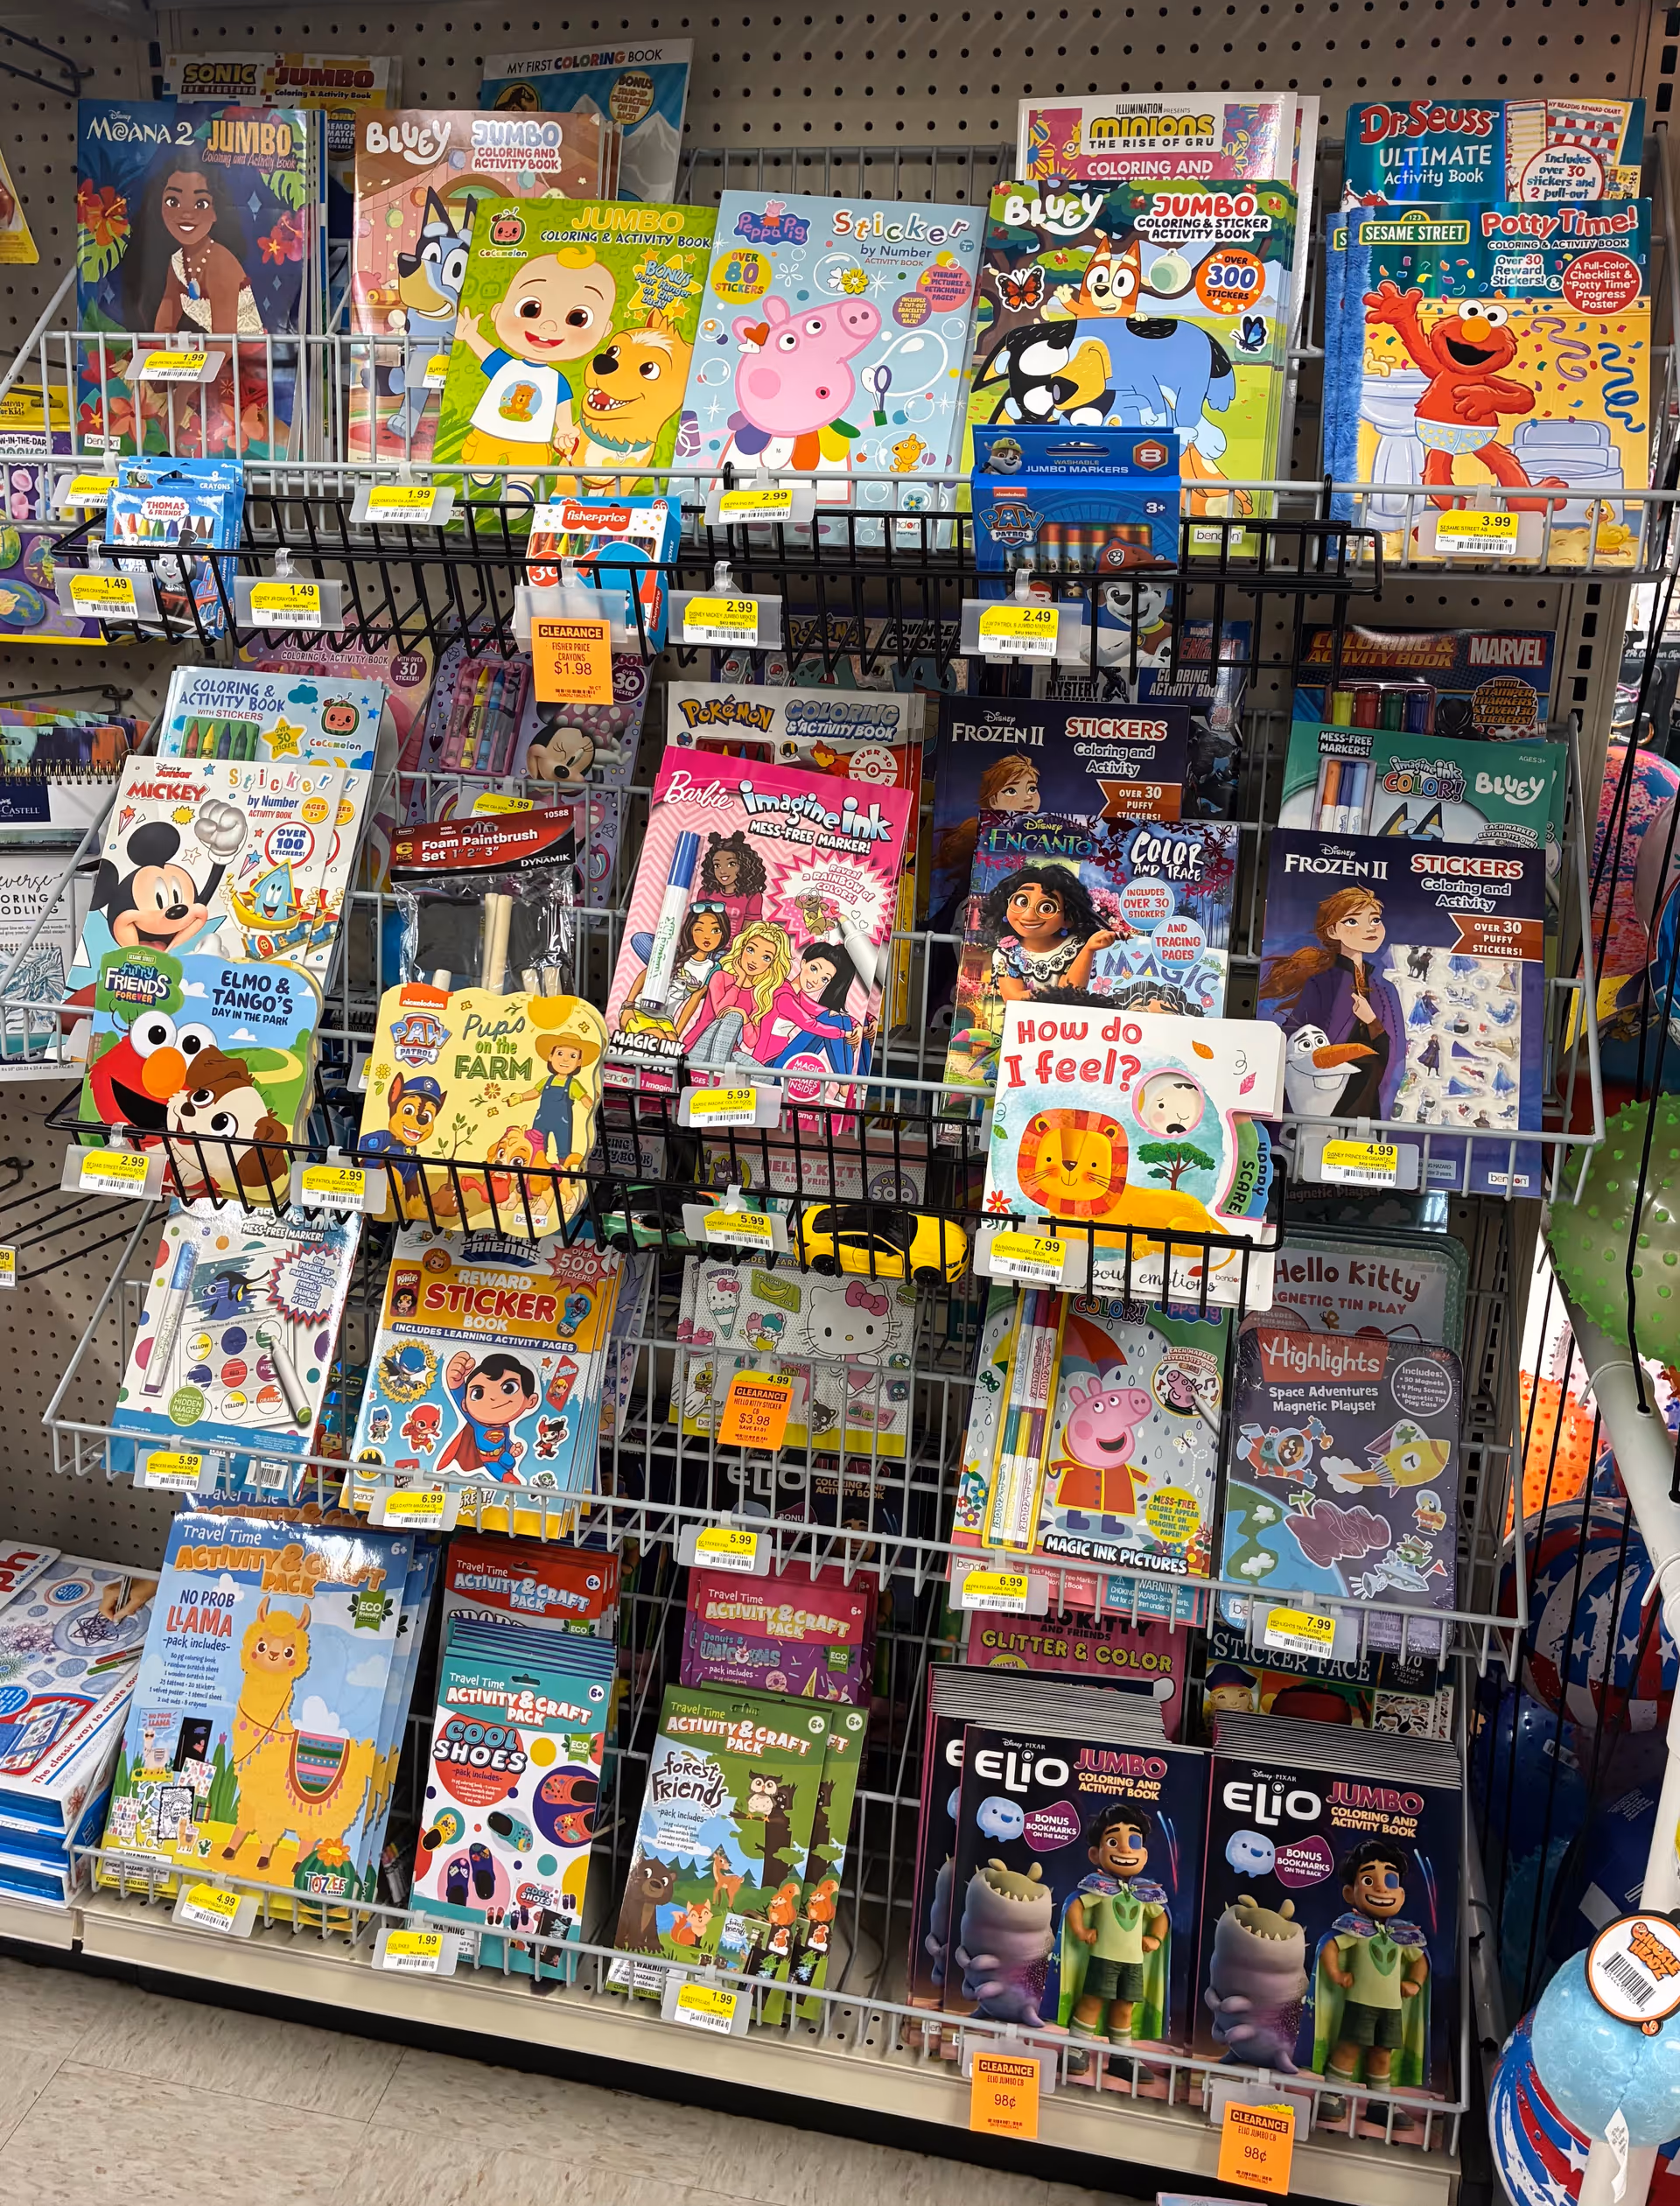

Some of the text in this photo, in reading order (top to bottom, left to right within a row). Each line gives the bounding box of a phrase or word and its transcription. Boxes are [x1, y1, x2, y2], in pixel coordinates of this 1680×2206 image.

[508, 49, 662, 74] MY FIRST COLORING BOOK
[183, 64, 257, 83] SONIC
[87, 116, 195, 146] MOANA 2
[206, 120, 291, 156] JUMBO
[472, 120, 563, 148] JUMBO
[366, 120, 452, 165] BLUEY
[1089, 137, 1214, 148] THE RISE OF GRU
[1380, 144, 1492, 166] ULTIMATE
[1384, 168, 1483, 186] Activity Book
[572, 207, 684, 233] JUMBO
[832, 209, 970, 243] Sticker
[1482, 206, 1638, 237] Potty Time!
[541, 231, 710, 249] COLORING & ACTIVITY BOOK
[1365, 225, 1464, 240] SESAME STREET
[732, 252, 759, 263] OVER
[860, 244, 932, 258] by Number
[1224, 256, 1248, 264] OVER
[724, 263, 760, 283] 80
[1208, 265, 1256, 288] 300
[715, 283, 764, 295] STICKERS
[1207, 290, 1249, 299] STICKERS
[1140, 448, 1161, 462] 8
[147, 501, 185, 511] THOMAS
[1146, 502, 1166, 513] 3+
[567, 510, 626, 523] fisher-price
[1482, 515, 1511, 528] 3.99
[103, 578, 127, 589] 1.49
[289, 585, 314, 596] 1.49
[727, 601, 752, 613] 2.99
[1024, 610, 1051, 623] 2.49
[541, 626, 603, 639] CLEARANCE
[552, 641, 571, 650] FISHER
[1470, 637, 1542, 665] MARVEL
[558, 652, 585, 662] CRAYONS
[554, 663, 592, 676] $1.98
[126, 782, 207, 802] MICKEY
[663, 771, 733, 809] Barbie
[544, 809, 569, 818] 10588
[277, 829, 306, 837] OVER
[422, 830, 537, 850] Foam Paintbrush
[750, 820, 872, 853] MESS-FREE MARKER!
[276, 837, 303, 850] 100
[521, 853, 570, 866] DYNAMIK
[1410, 854, 1522, 879] STICKERS
[1127, 888, 1166, 897] INCLUDES
[1422, 879, 1511, 896] Coloring and
[1124, 899, 1169, 908] OVER 30
[1436, 896, 1495, 912] Activity
[1128, 909, 1166, 918] STICKERS
[220, 970, 290, 995] ELMO &
[212, 988, 293, 1013] TANGO'S
[212, 1008, 288, 1026] DAY IN THE PARK
[463, 1014, 525, 1040] Pups
[1018, 1017, 1143, 1043] How do
[475, 1040, 517, 1054] on the
[454, 1055, 533, 1080] FARM
[1004, 1049, 1141, 1092] I feel?
[727, 1090, 750, 1100] 5.99
[1367, 1145, 1393, 1156] 4.99
[121, 1155, 144, 1167] 2.99
[340, 1170, 362, 1181] 2.99
[741, 1215, 764, 1225] 5.99
[571, 1248, 592, 1258] OVER
[1034, 1238, 1060, 1252] 7.99
[561, 1253, 597, 1275] 500
[458, 1271, 532, 1288] REWARD
[425, 1283, 556, 1323] STICKER
[1339, 1299, 1406, 1315] TIN PLAY
[463, 1315, 508, 1331] BOOK
[395, 1323, 574, 1352] INCLUDES LEARNING ACTIVITY PAGES
[735, 1388, 787, 1401] CLEARANCE
[1269, 1385, 1379, 1403] Space Adventures
[172, 1405, 200, 1415] IMAGES
[739, 1413, 770, 1425] $3.98
[178, 1456, 199, 1465] 5.99
[422, 1494, 443, 1502] 6.99
[731, 1534, 751, 1544] 5.99
[1046, 1537, 1186, 1573] MAGIC INK PICTURES
[1000, 1577, 1022, 1587] 6.99
[180, 1589, 234, 1607] NO PROB
[166, 1606, 232, 1638] LLAMA
[1306, 1616, 1331, 1630] 7.99
[982, 1635, 1173, 1672] GLITTER & COLOR
[450, 1672, 505, 1689] Travel Time
[446, 1687, 592, 1724] ACTIVITY & CRAFT
[507, 1708, 546, 1726] PACK
[445, 1720, 517, 1751] COOL
[433, 1740, 528, 1773] SHOES
[1074, 1748, 1167, 1779] JUMBO
[1078, 1772, 1161, 1790] COLORING AND
[1078, 1783, 1159, 1800] ACTIVITY BOOK
[1035, 1814, 1069, 1825] BONUS
[1026, 1822, 1077, 1835] BOOKMARKS
[216, 1893, 235, 1906] 4.99
[417, 1935, 437, 1945] 1.99
[712, 1992, 732, 2005] 1.99
[980, 2060, 1033, 2077] CLEARANCE
[994, 2093, 1016, 2109] 98¢
[1243, 2146, 1267, 2162] 98¢
